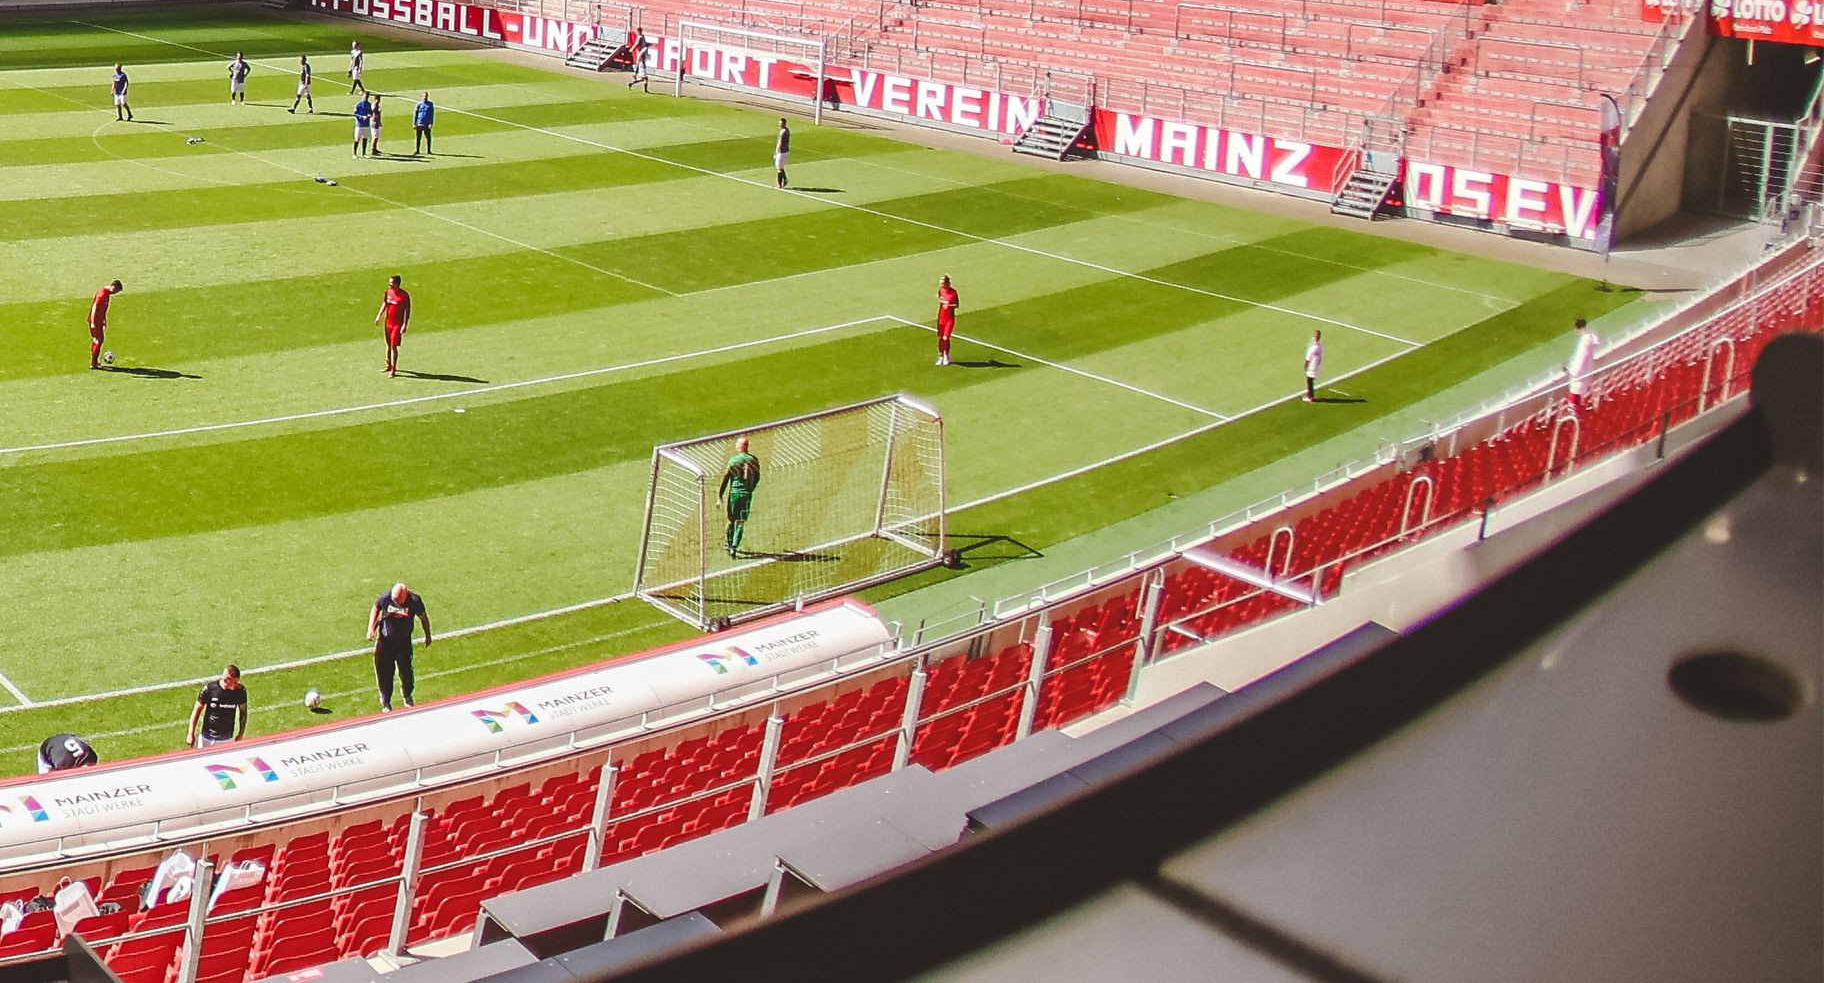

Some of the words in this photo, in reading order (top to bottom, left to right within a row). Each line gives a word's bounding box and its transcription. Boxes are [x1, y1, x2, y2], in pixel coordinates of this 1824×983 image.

[851, 69, 1041, 136] VEREIN
[1114, 112, 1312, 188] MAINZ
[754, 630, 820, 653] MAINZER
[537, 686, 614, 710] MAINZER
[281, 743, 370, 767] MAINZER
[54, 783, 152, 807] MAINZER
